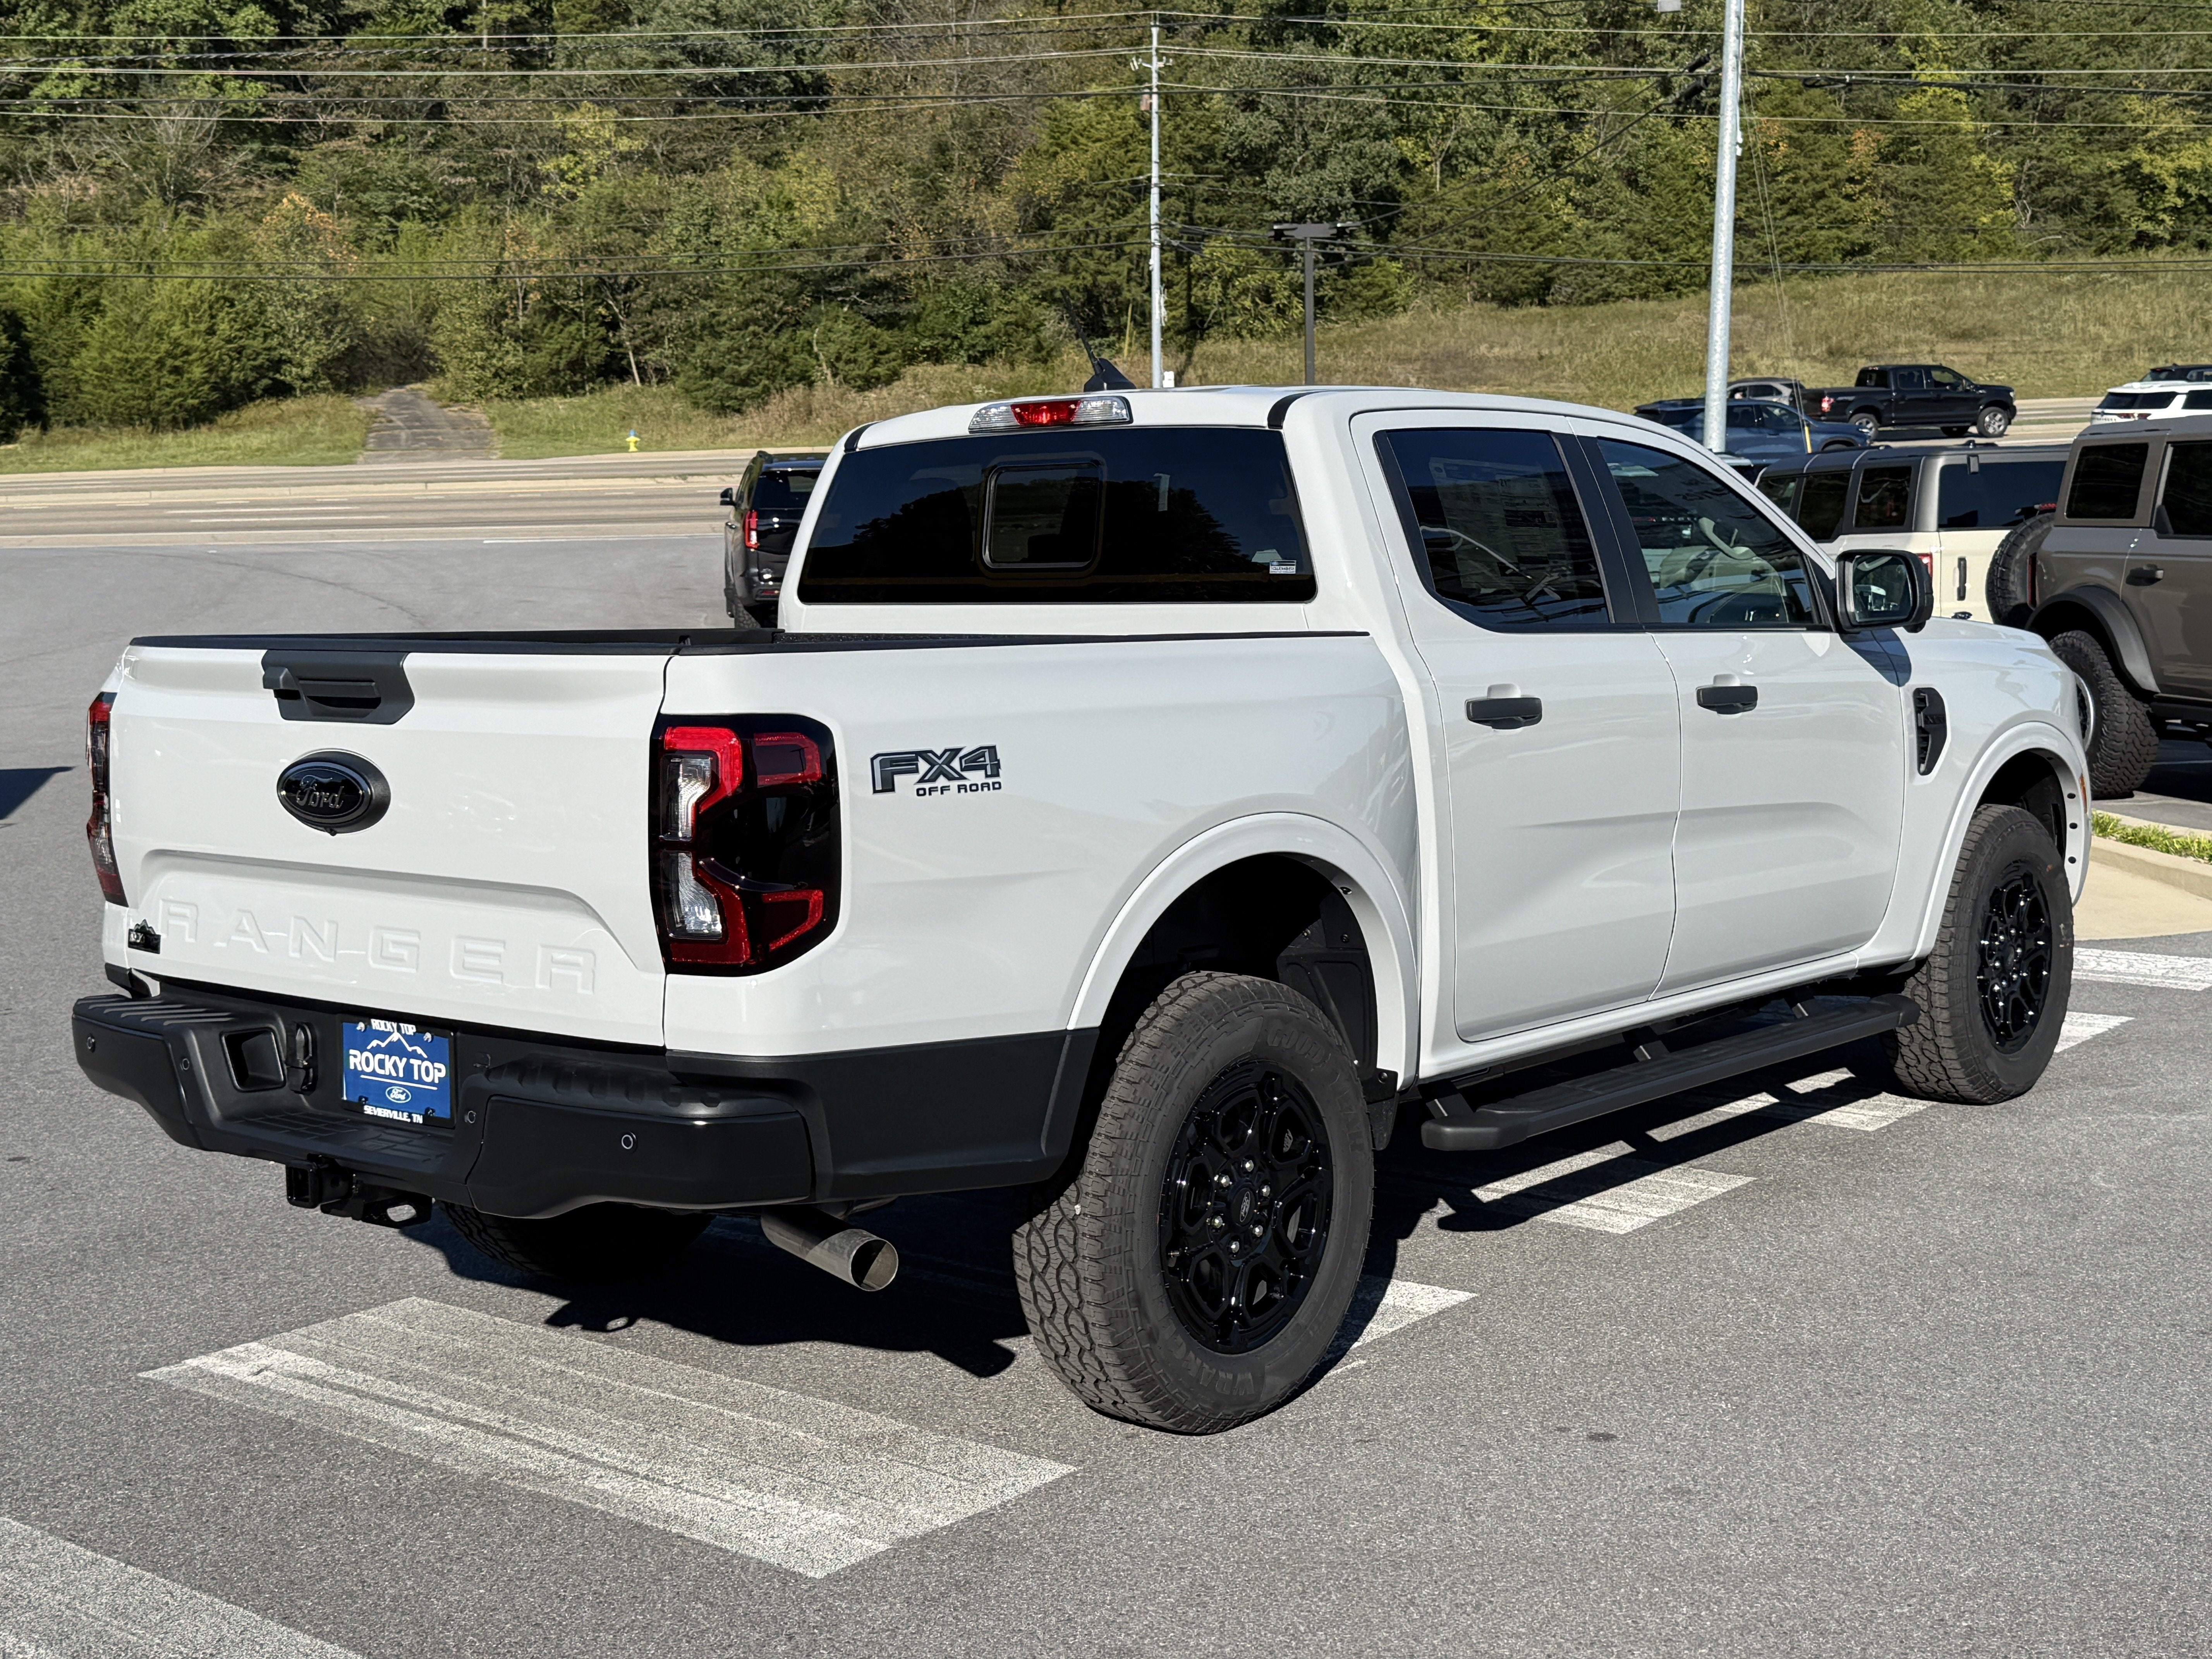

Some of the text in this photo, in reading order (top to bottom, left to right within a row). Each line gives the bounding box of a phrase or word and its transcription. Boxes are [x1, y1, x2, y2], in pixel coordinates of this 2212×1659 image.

[870, 744, 1001, 795] FX4
[296, 774, 345, 809] Ford
[916, 781, 1002, 797] OFF ROAD
[158, 898, 596, 994] RANGER
[371, 1018, 416, 1036] ROCKY TOP
[349, 1049, 446, 1084] ROCKY TOP
[390, 1087, 407, 1100] Ford
[412, 1113, 423, 1123] TN
